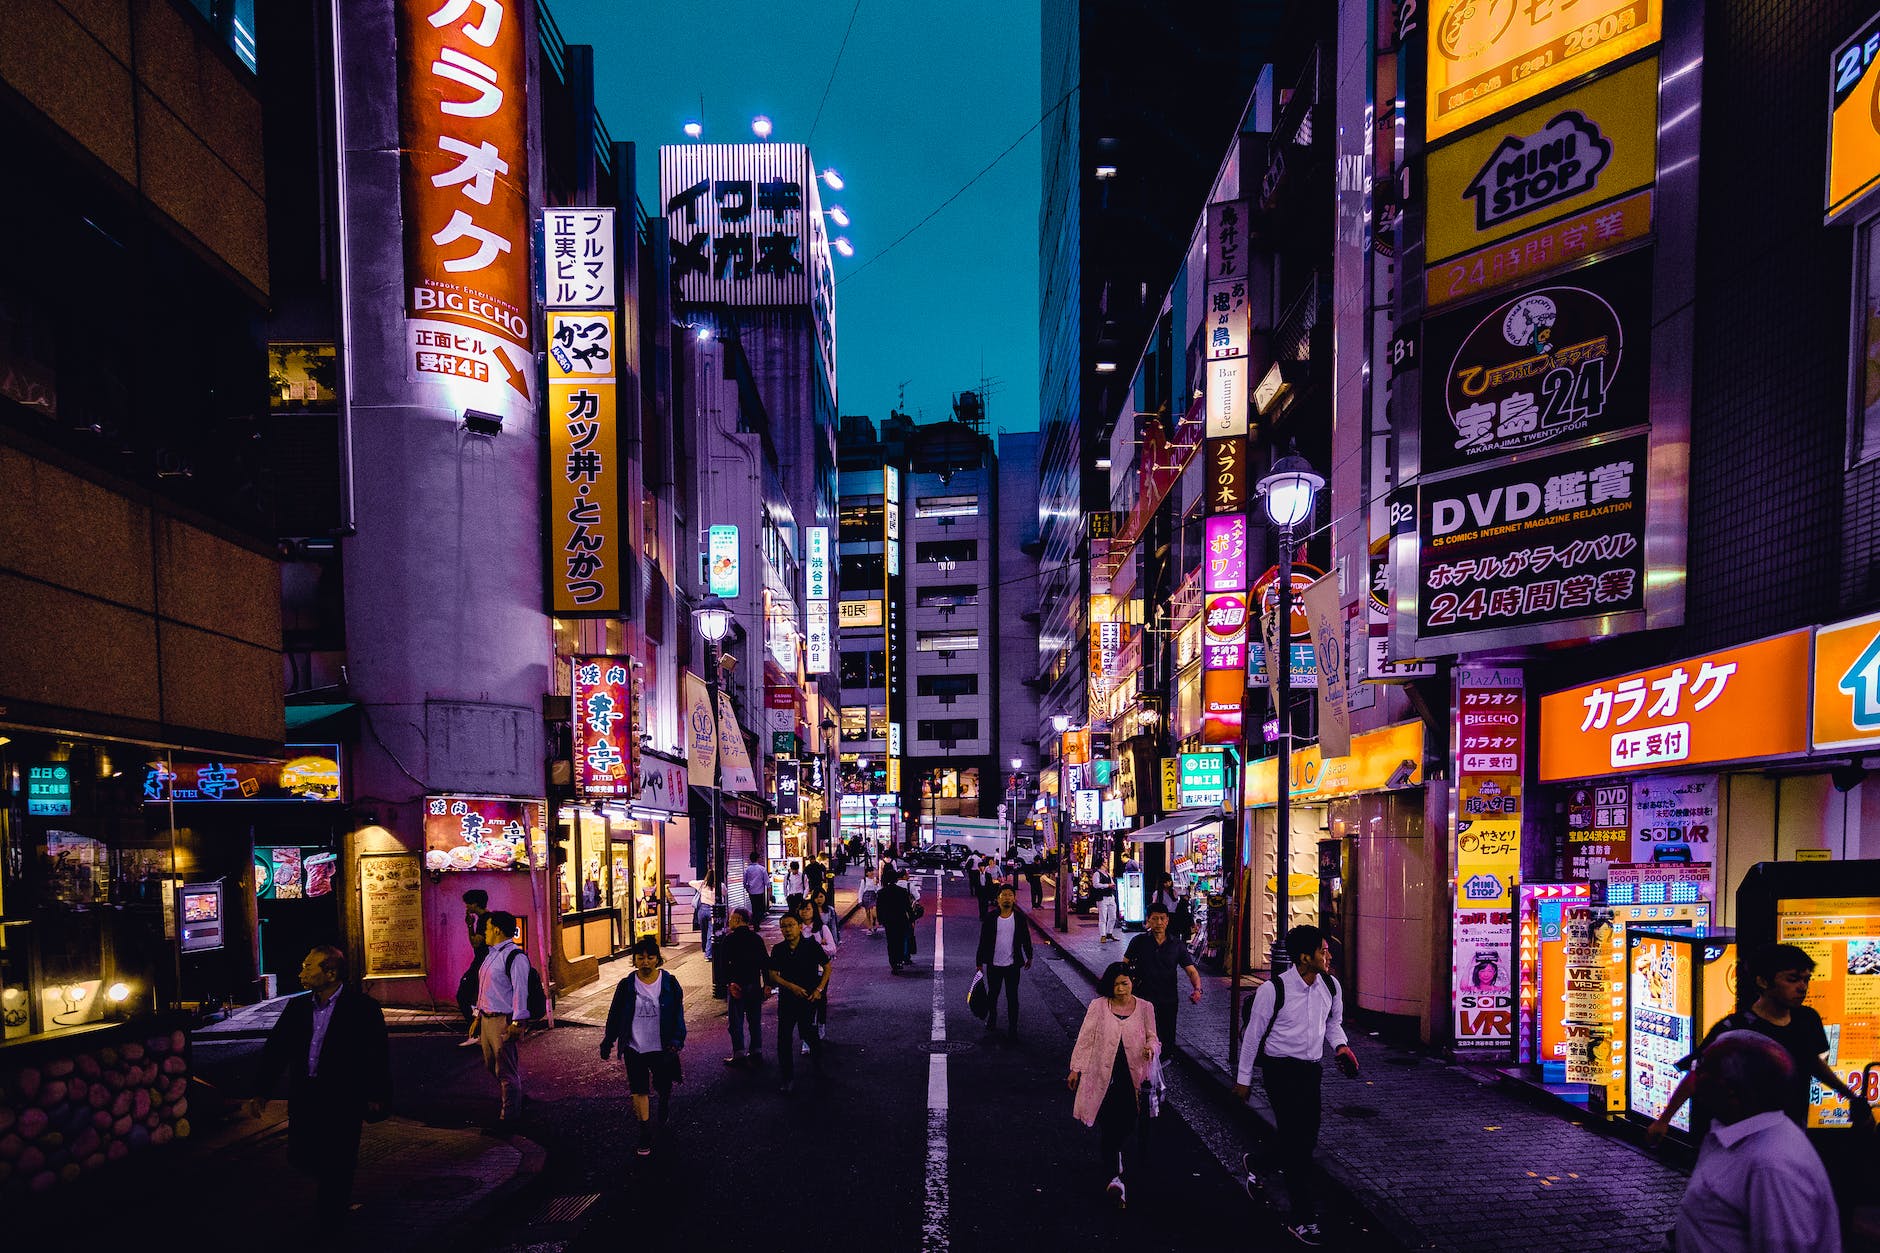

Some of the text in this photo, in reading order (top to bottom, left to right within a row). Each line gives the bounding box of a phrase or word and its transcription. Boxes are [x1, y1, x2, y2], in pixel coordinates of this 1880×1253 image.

[426, 0, 511, 273] カラオケ
[1496, 133, 1577, 188] MINI
[1491, 159, 1580, 214] STOP
[554, 215, 577, 303] 正実ビル
[583, 214, 605, 302] ブルマン
[1447, 211, 1625, 297] 24時間営業
[424, 278, 520, 313] Karaoke Entertainment
[414, 287, 528, 339] BIG ECHO
[415, 329, 488, 355] 正面ビル
[553, 320, 609, 370] かつや
[1394, 339, 1414, 366] B1
[419, 353, 487, 379] 受付4F
[1218, 367, 1237, 378] Bar
[1465, 420, 1588, 456] TAKARAJIMA TWENTY FOUR
[1216, 440, 1237, 504] バラの木
[566, 389, 604, 604] カツ丼・とんかつ
[1431, 461, 1635, 536] DVD鑑賞
[1390, 502, 1413, 527] B2
[1432, 501, 1632, 547] CS COMICS INTERNET MAGAZINE RELAXATION
[1230, 519, 1246, 560] スナック
[1427, 533, 1637, 589] ホテルがライバル
[811, 557, 823, 596] 渋谷会
[841, 604, 866, 616] 和民
[1426, 568, 1636, 626] 24時間営業
[1207, 608, 1246, 626] 楽園
[1211, 655, 1239, 666] 右折
[1464, 693, 1518, 706] カラオケ
[1580, 661, 1737, 732] カラオケ
[1464, 714, 1519, 725] BIG ECHO
[1463, 736, 1517, 749] カラオケ
[1616, 730, 1682, 760] 4F 受付
[574, 722, 585, 798] RESTAURANT
[1199, 758, 1220, 770] 日立
[1467, 757, 1512, 768] 4F 受付
[1596, 789, 1627, 804] DVD
[1458, 822, 1470, 830] 2F
[1596, 809, 1627, 827] 鑑賞
[1479, 830, 1516, 842] やきとり
[1480, 843, 1517, 854] センター
[1471, 888, 1495, 896] STOP
[1609, 874, 1710, 884] 1500円 2000円 2500円
[1704, 947, 1721, 960] 2F
[1569, 969, 1592, 980] VR
[1461, 996, 1512, 1008] SOD
[1460, 1010, 1512, 1035] VR
[1568, 1027, 1590, 1037] VR
